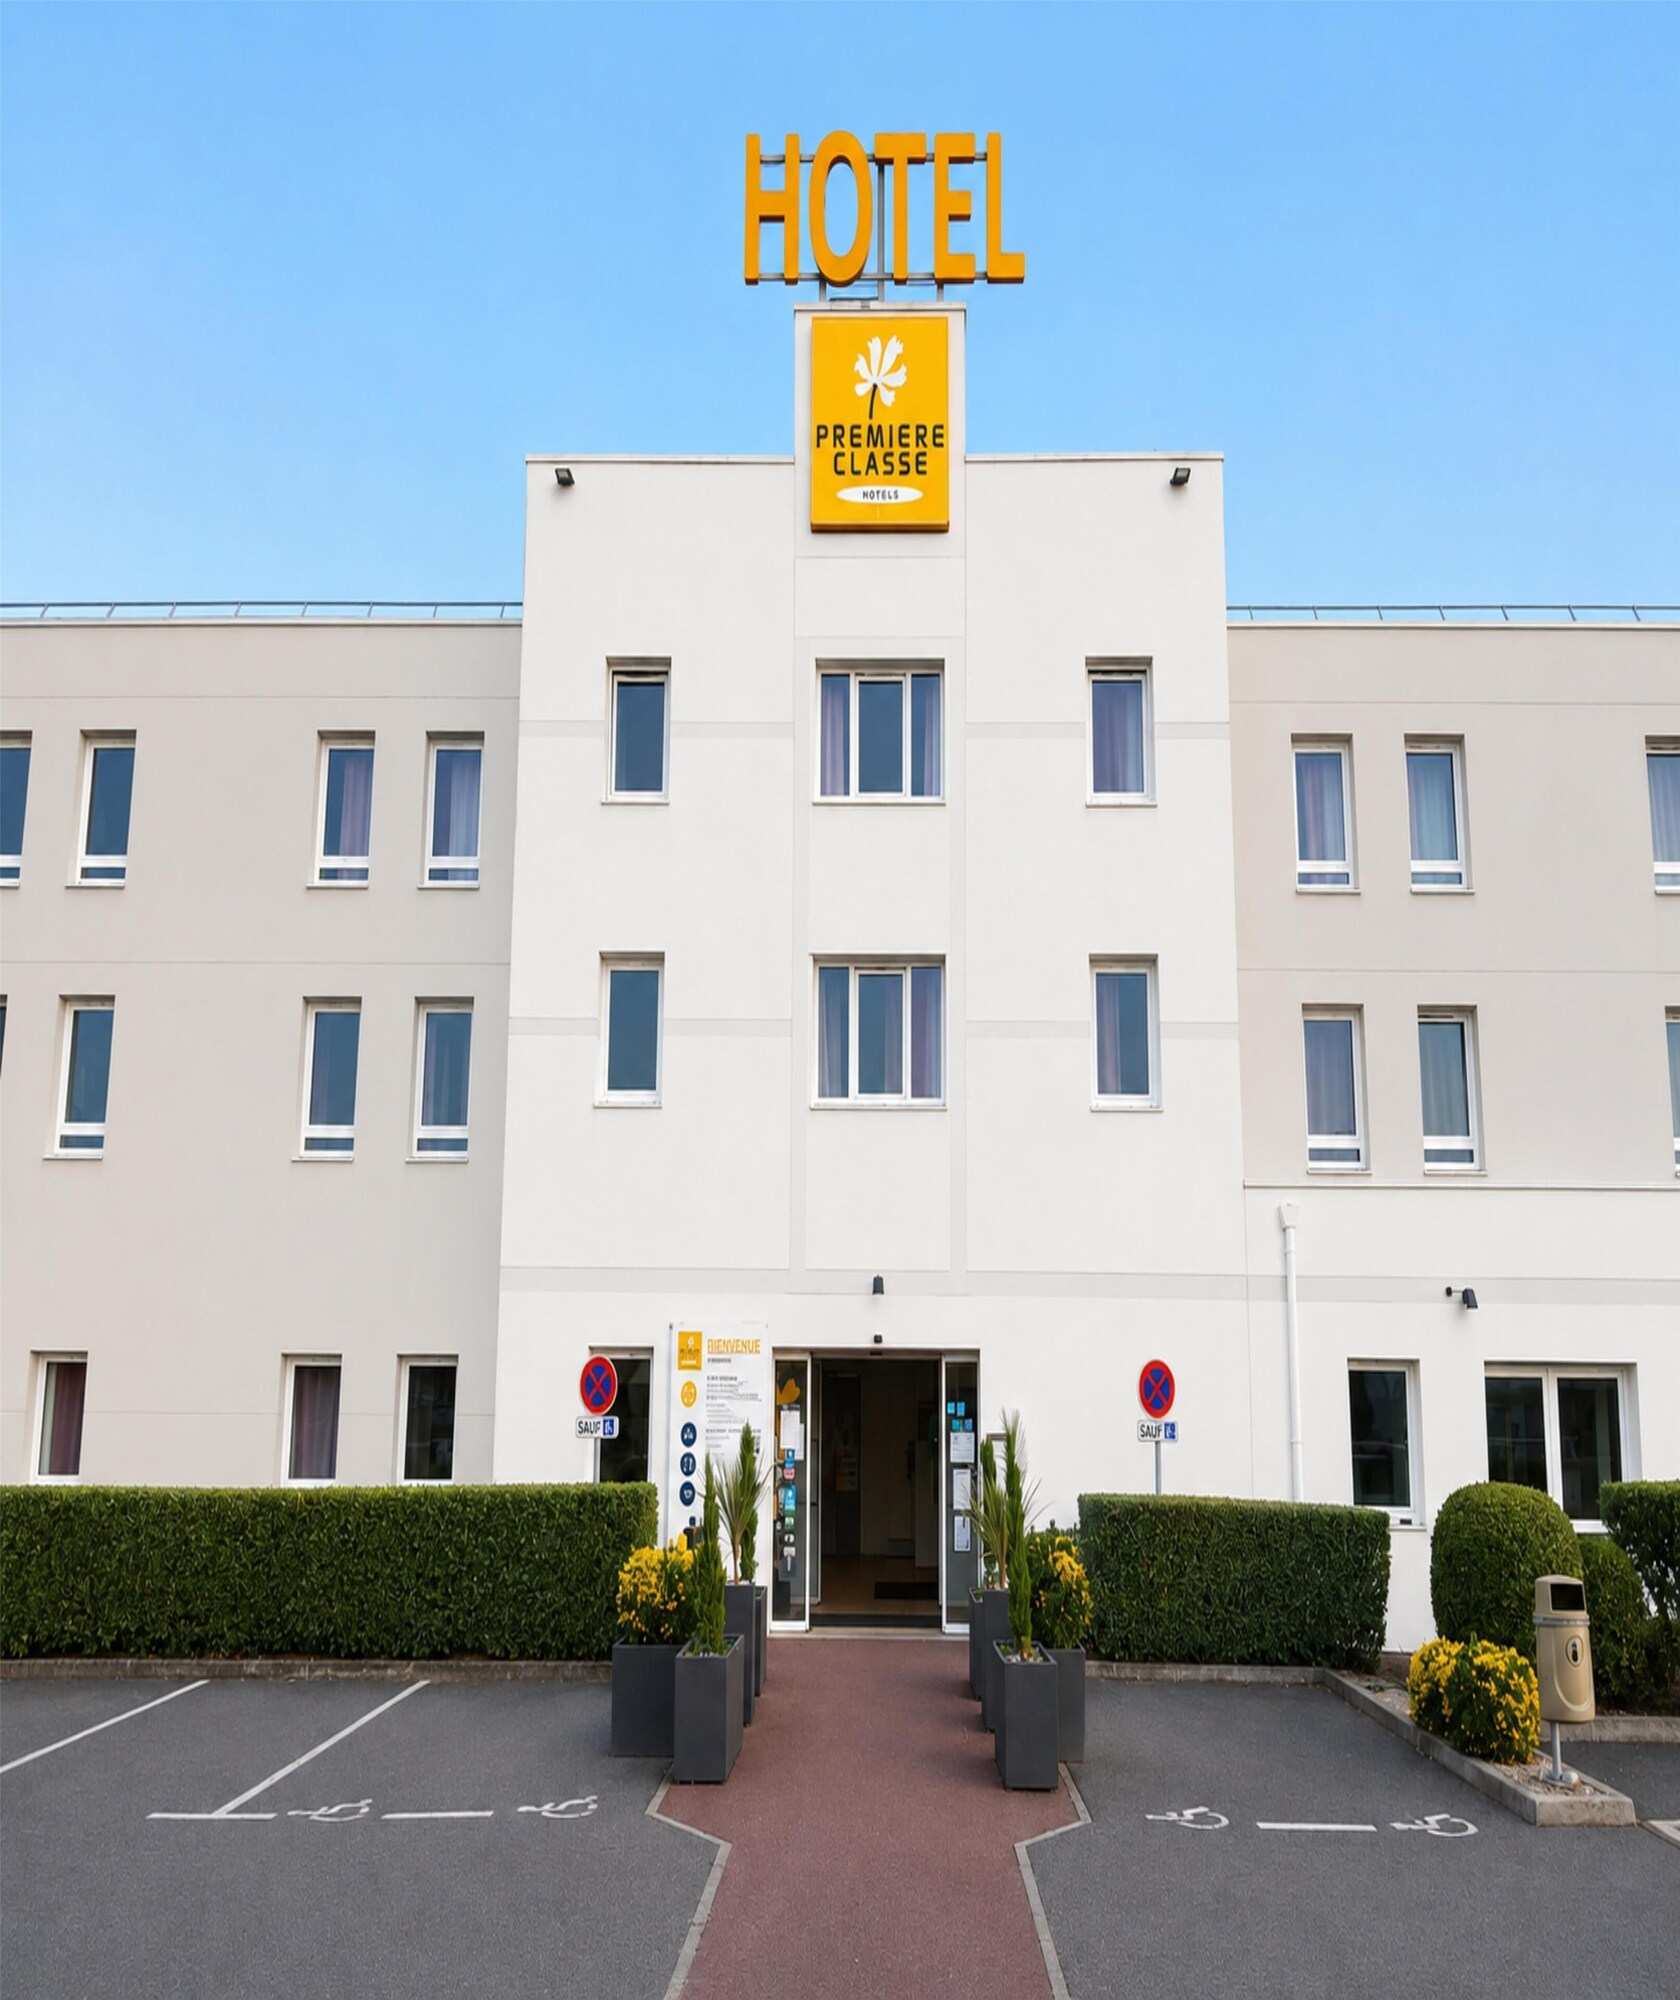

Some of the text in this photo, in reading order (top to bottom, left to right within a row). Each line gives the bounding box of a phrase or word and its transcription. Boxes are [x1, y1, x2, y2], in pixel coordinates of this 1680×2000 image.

[744, 130, 1025, 287] HOTEL
[816, 423, 945, 449] PREMIERE
[833, 451, 928, 476] CLASSE
[862, 489, 899, 501] HOTELS
[707, 1338, 761, 1355] BIENVENUE
[578, 1420, 601, 1435] SAUF
[1140, 1423, 1163, 1438] SAUF
